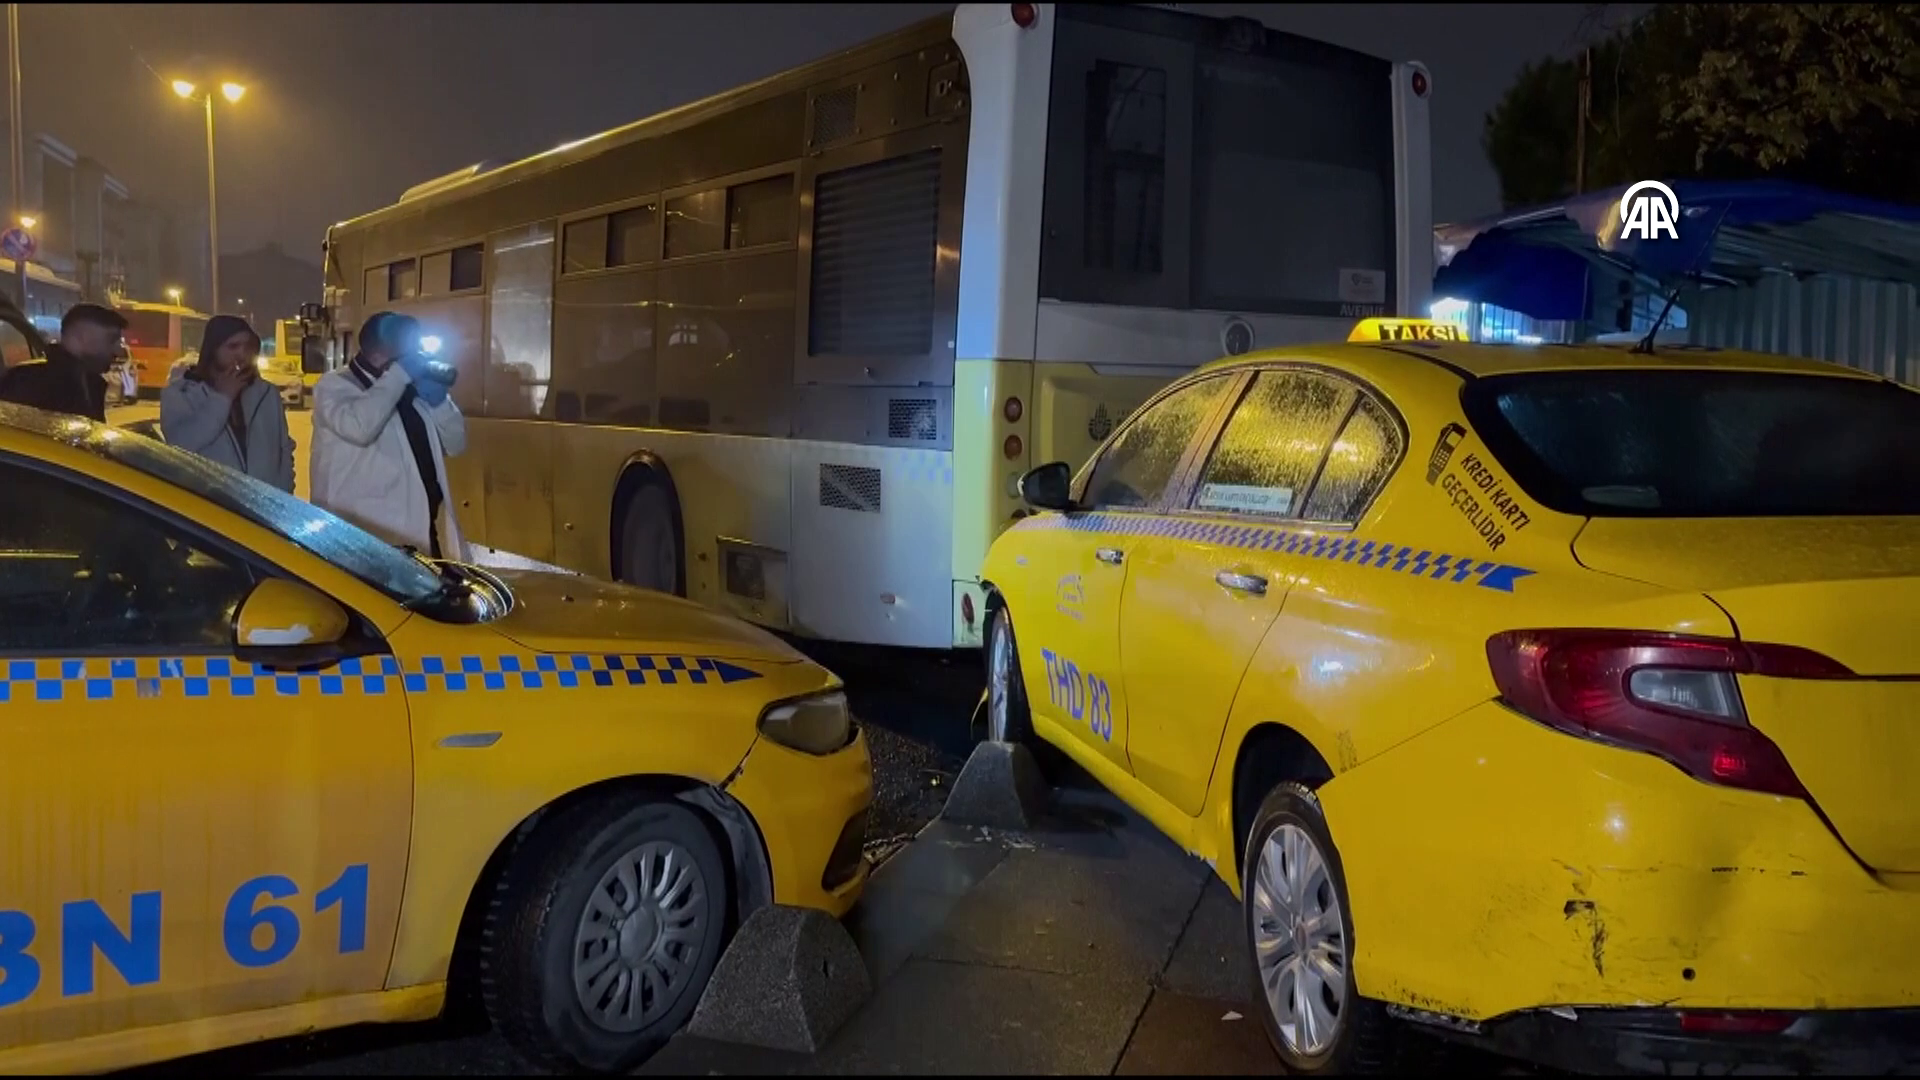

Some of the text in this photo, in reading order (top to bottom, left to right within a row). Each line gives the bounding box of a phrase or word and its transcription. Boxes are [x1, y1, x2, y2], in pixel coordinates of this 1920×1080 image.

[1339, 303, 1384, 317] AVENUE
[1441, 473, 1506, 552] GEÇERLİDİR
[1460, 453, 1531, 532] KREDİ KARTI
[1041, 647, 1112, 743] THD 83
[223, 863, 369, 968] 61
